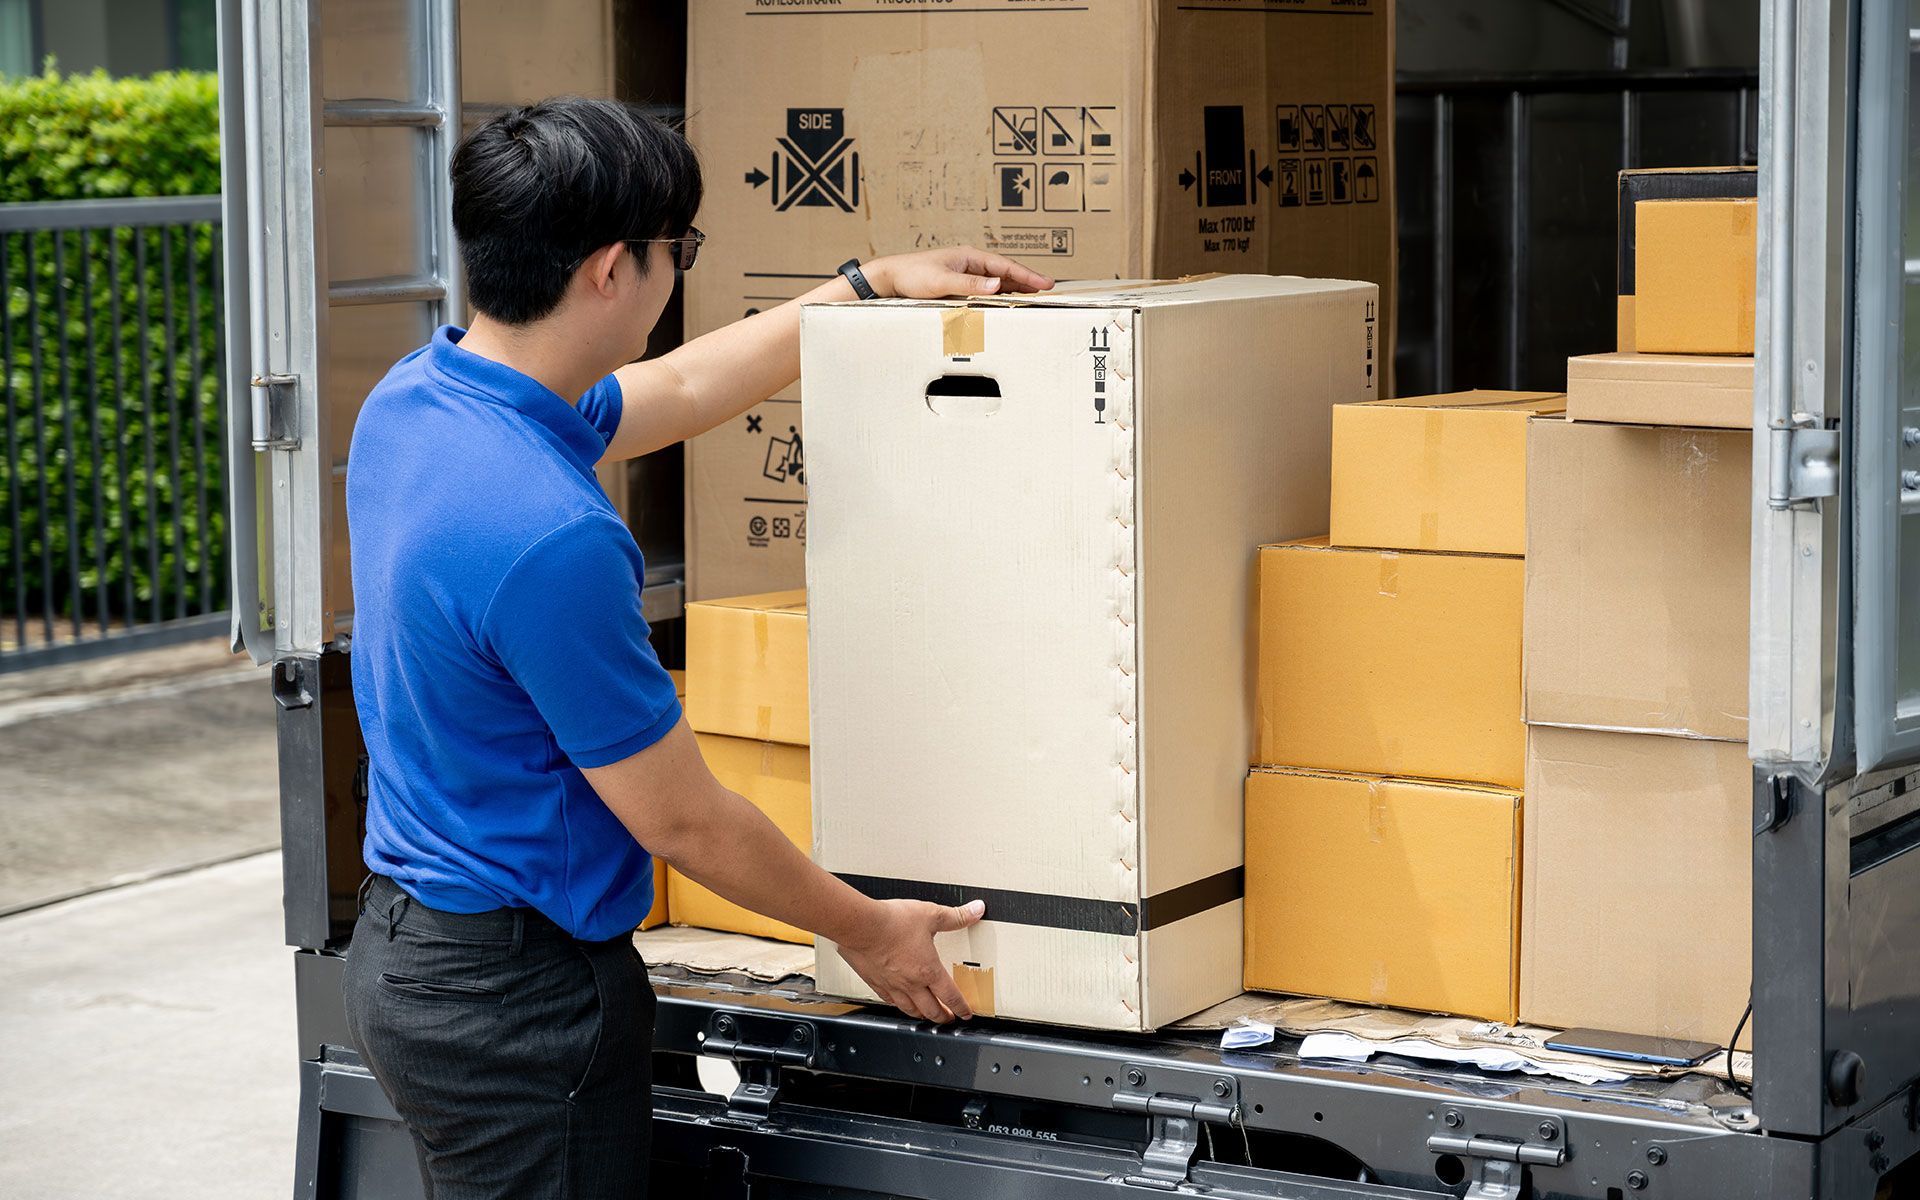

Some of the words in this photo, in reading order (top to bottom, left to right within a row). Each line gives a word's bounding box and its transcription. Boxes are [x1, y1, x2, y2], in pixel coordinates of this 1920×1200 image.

[799, 113, 832, 129] SIDE
[1209, 170, 1242, 186] FRONT
[1286, 172, 1294, 194] 2
[1198, 218, 1219, 233] Max
[1220, 216, 1242, 233] 1700
[1014, 233, 1038, 242] stacking
[1056, 237, 1063, 248] 3
[1204, 239, 1220, 252] Max
[1222, 238, 1236, 251] 770
[988, 1124, 1009, 1134] 053
[1035, 1130, 1057, 1140] 555
